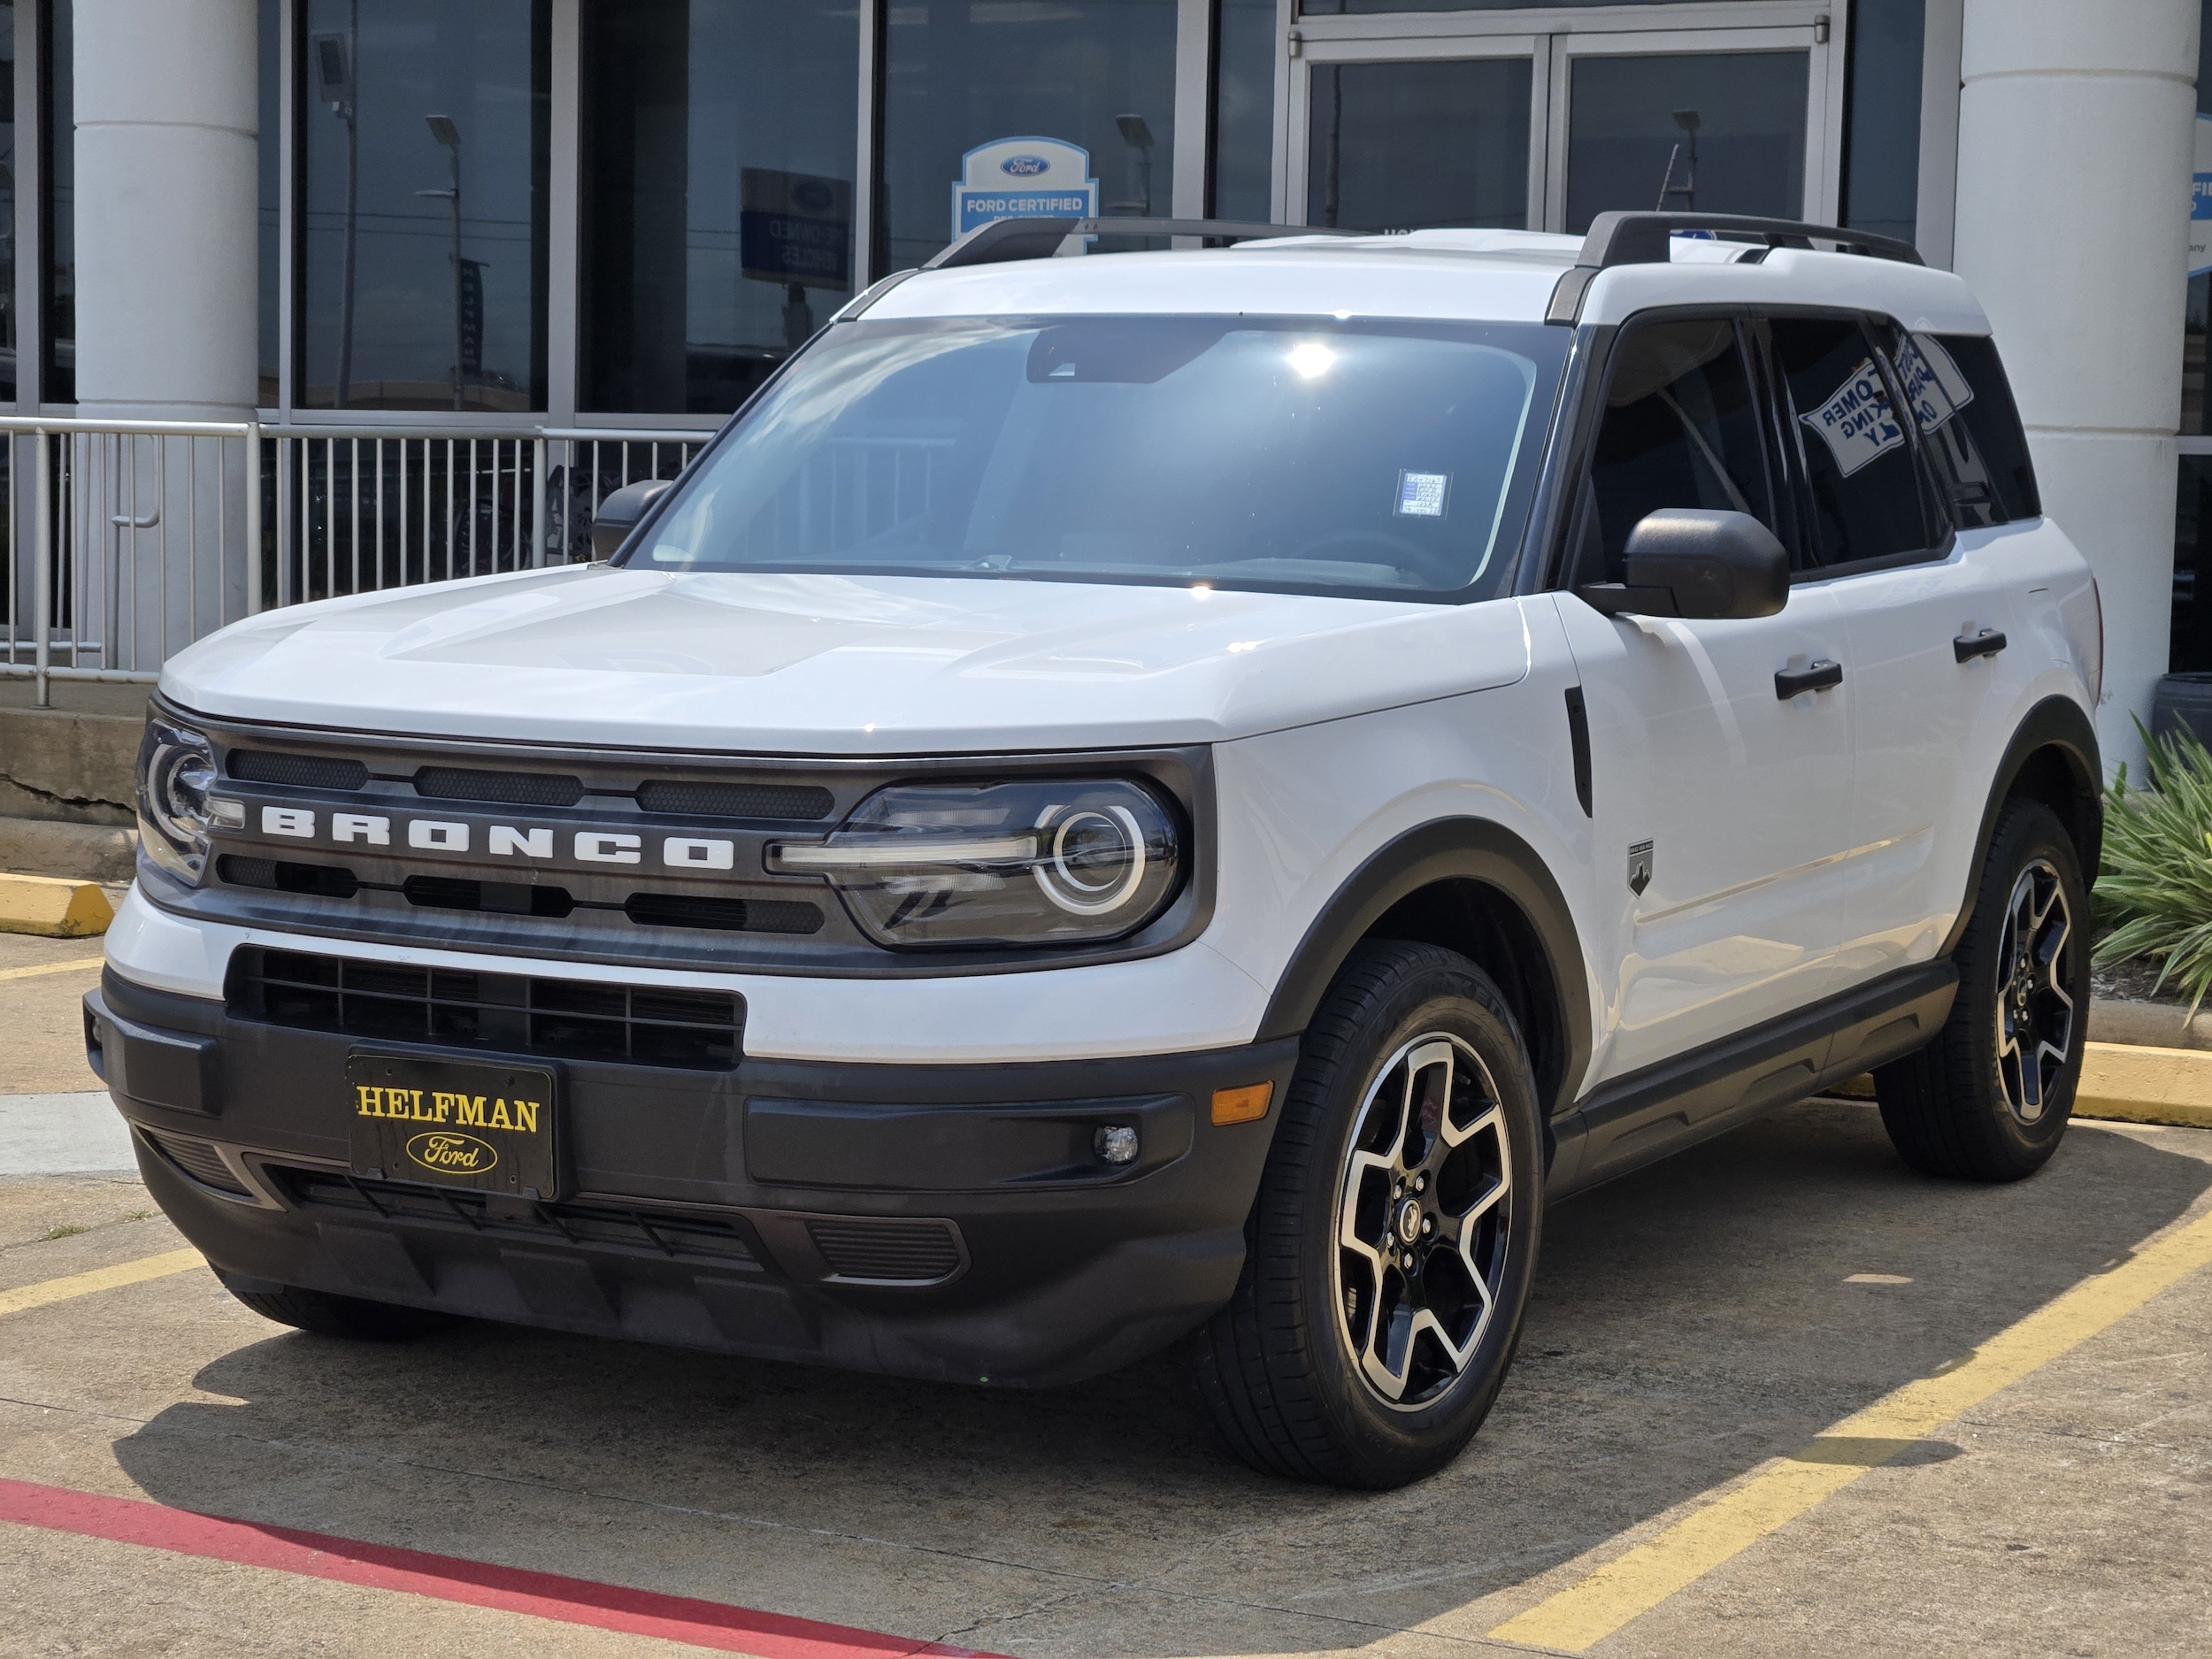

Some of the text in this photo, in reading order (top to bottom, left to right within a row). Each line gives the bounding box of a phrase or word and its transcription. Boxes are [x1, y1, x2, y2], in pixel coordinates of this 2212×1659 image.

[1010, 158, 1041, 173] Ford
[967, 197, 1083, 213] FORD CERTIFIED
[262, 806, 734, 870] BRONCO
[357, 1086, 541, 1133] HELFMAN
[424, 1135, 480, 1168] Ford
